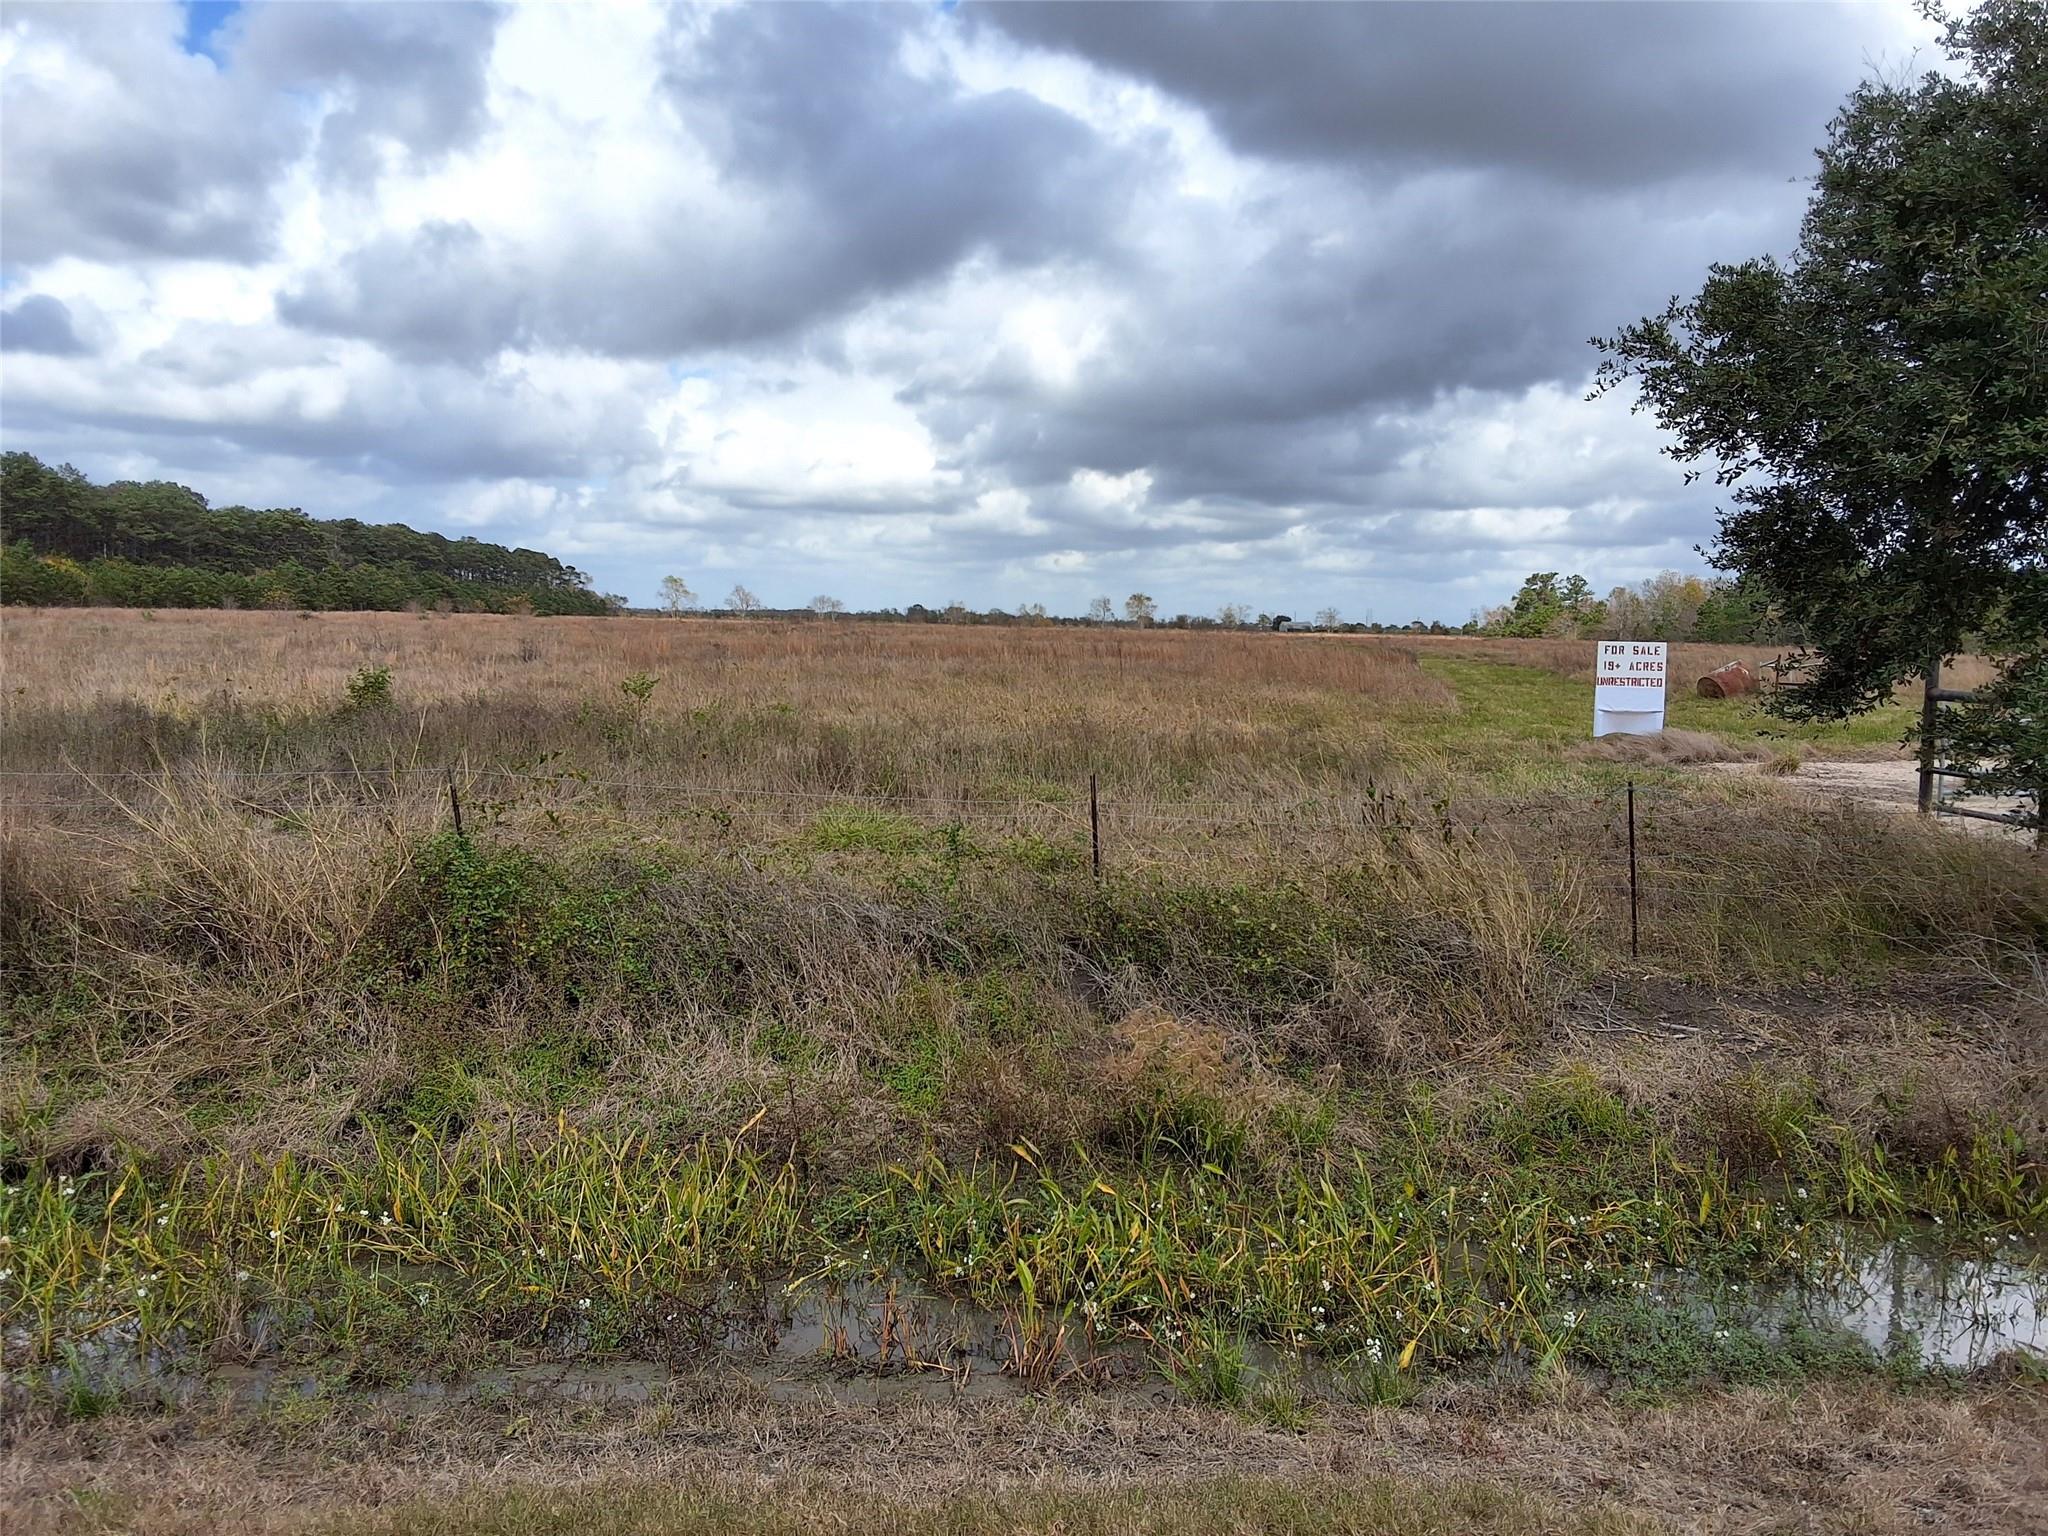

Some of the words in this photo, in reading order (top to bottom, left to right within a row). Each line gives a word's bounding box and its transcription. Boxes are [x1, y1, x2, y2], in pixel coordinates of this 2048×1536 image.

[1604, 645, 1625, 655] FOR
[1633, 646, 1661, 656] SALE
[1604, 661, 1621, 671] 19+
[1629, 661, 1663, 671] ACRES
[1596, 676, 1663, 687] UNRESTRICTED
